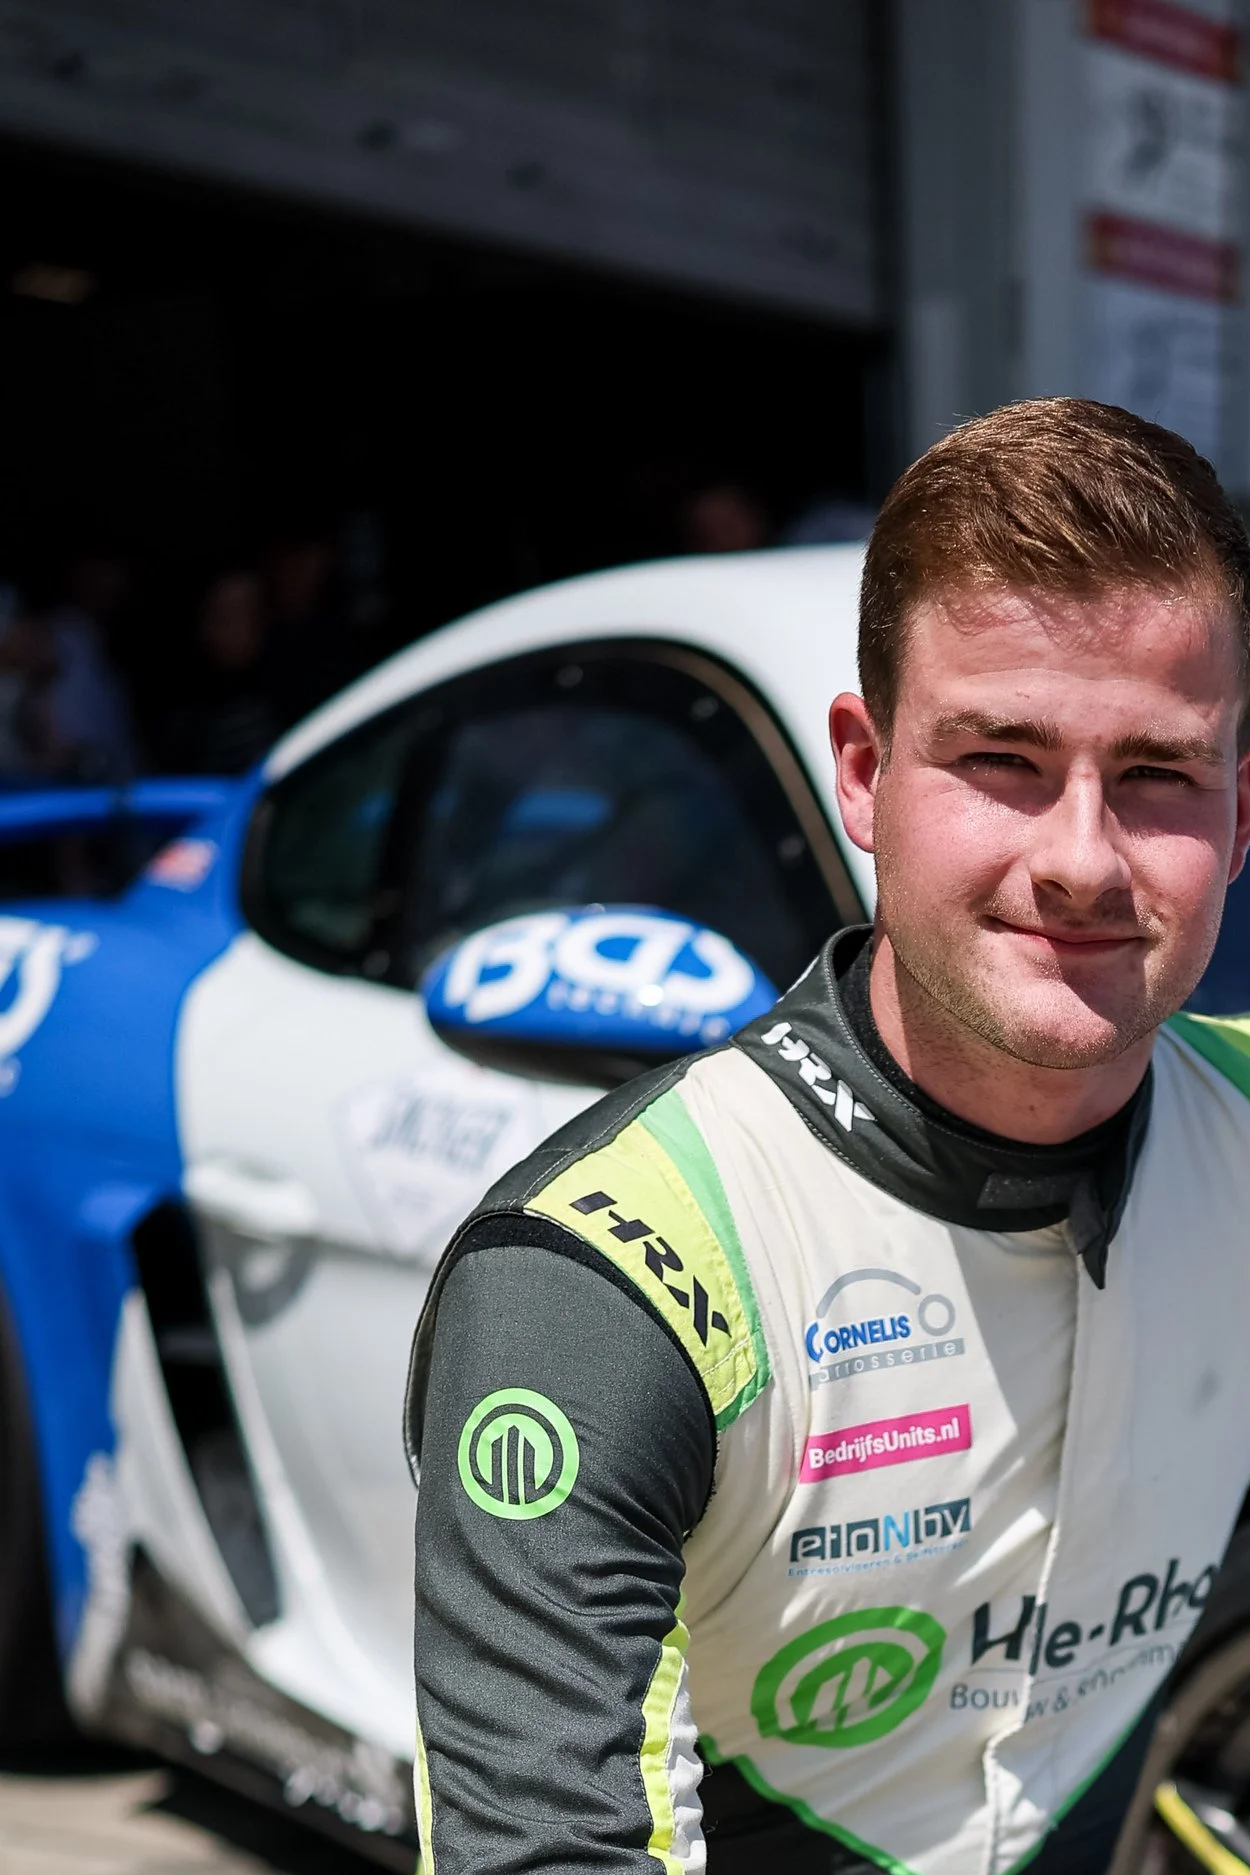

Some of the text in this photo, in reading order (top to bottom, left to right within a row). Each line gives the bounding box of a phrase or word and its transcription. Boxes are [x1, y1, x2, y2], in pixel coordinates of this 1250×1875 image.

[760, 1021, 876, 1133] HRX
[569, 1190, 730, 1347] HRX
[805, 1314, 911, 1363] CORNELIS
[807, 1416, 960, 1470] BedrijfsUnits.nl
